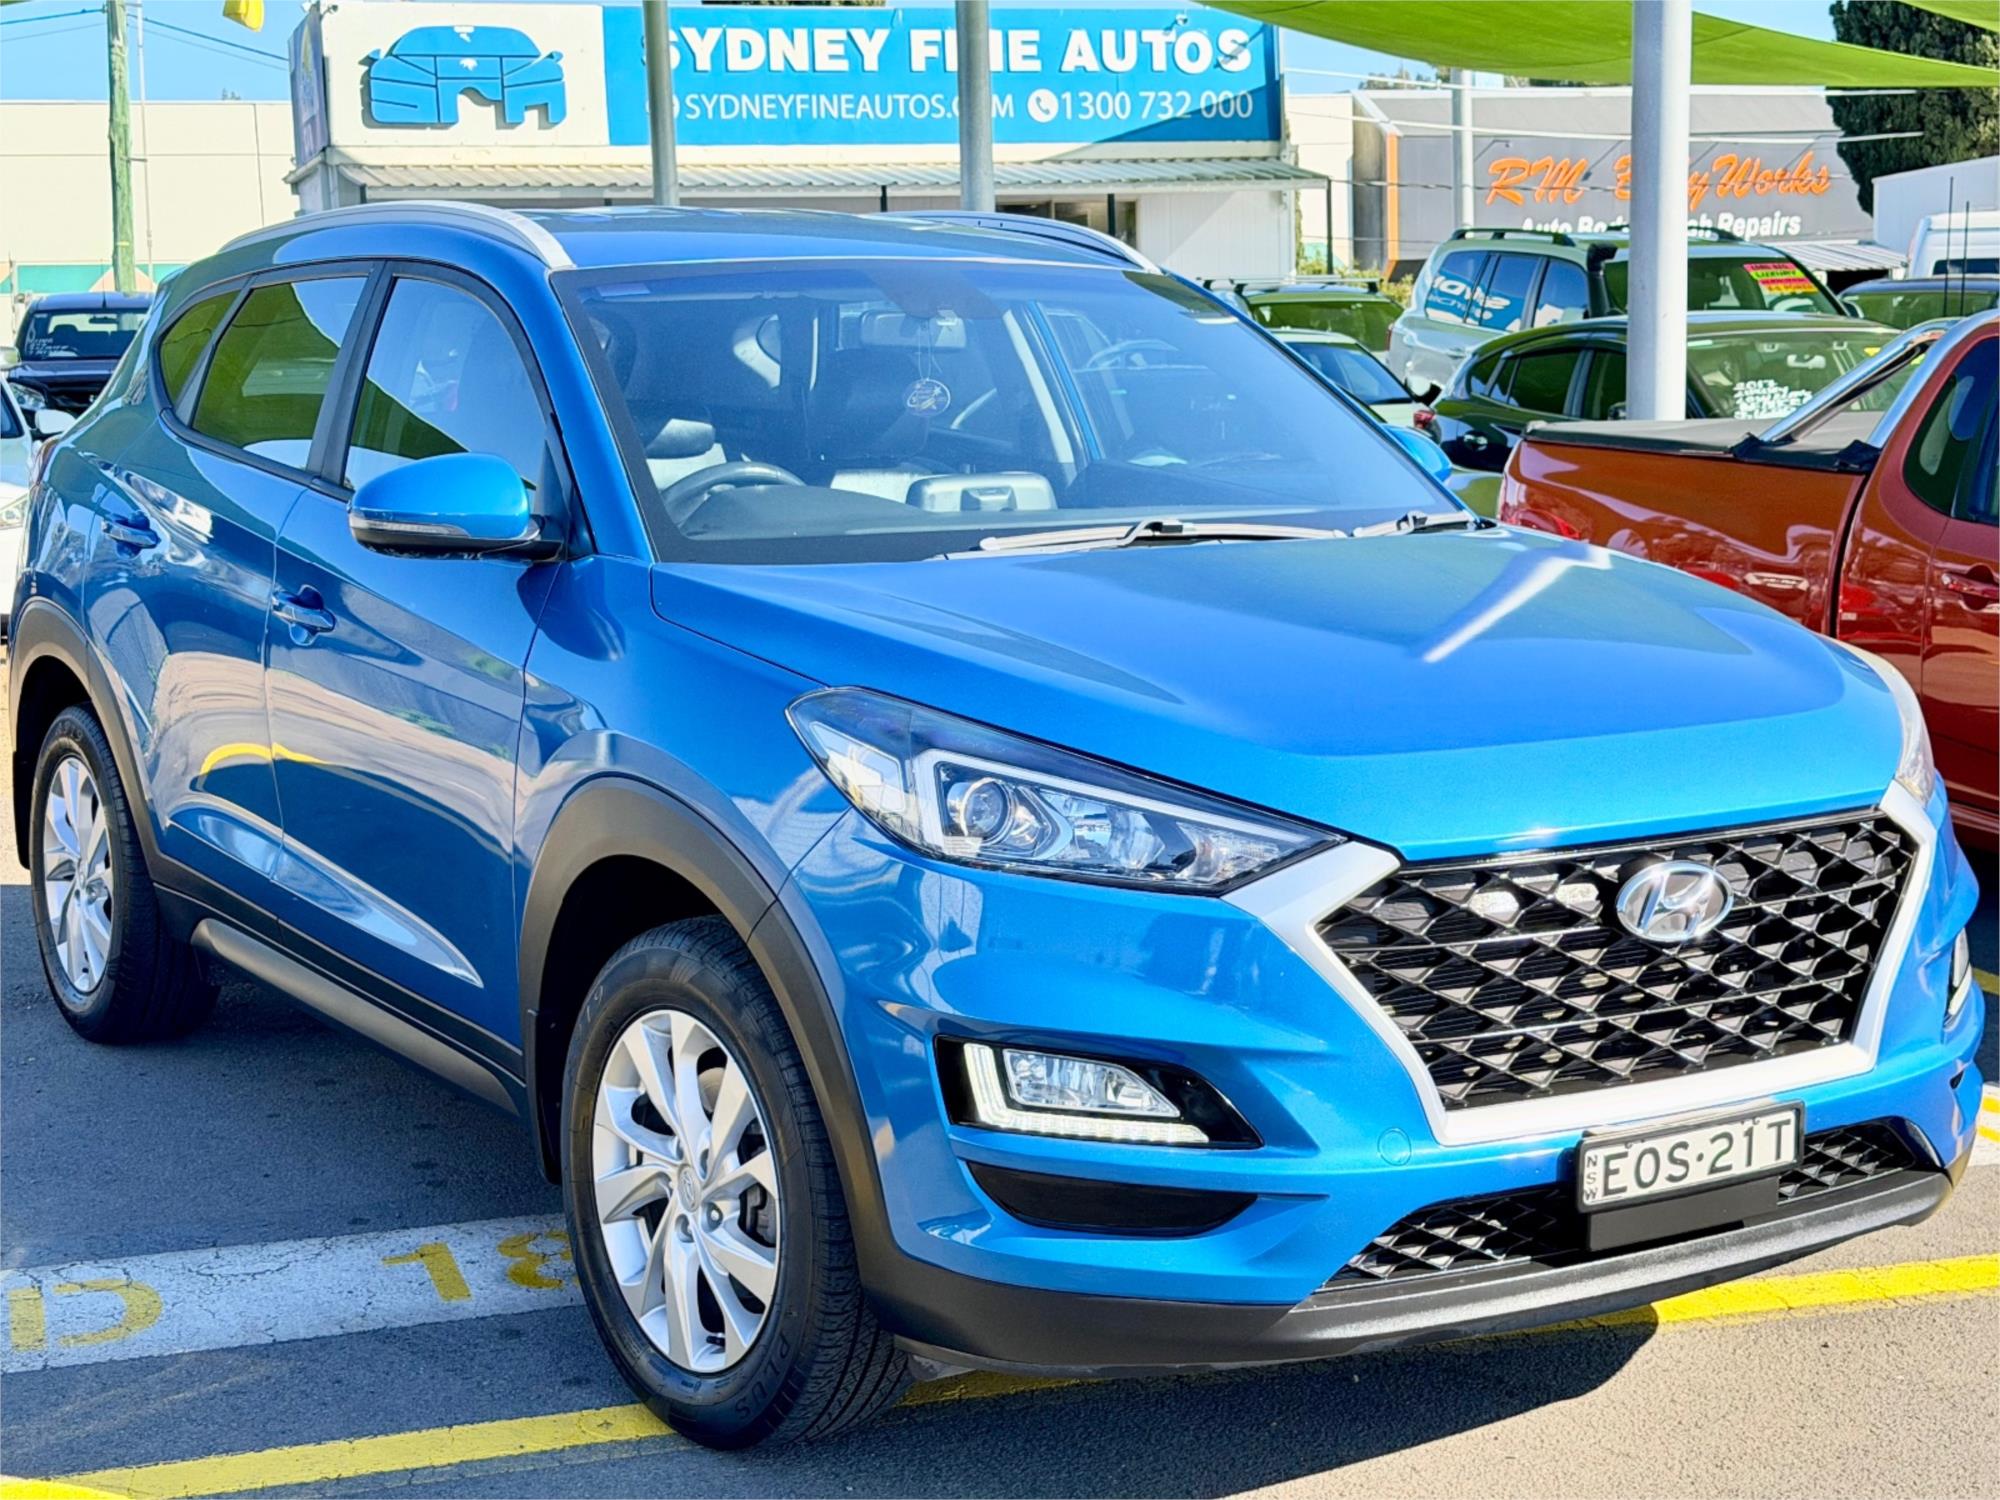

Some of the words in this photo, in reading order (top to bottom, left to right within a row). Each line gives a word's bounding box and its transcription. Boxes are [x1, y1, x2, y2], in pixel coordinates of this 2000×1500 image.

[1060, 29, 1252, 74] AUTOS
[685, 93, 1015, 119] SYDNEYFINEAUTOS.M
[1061, 91, 1131, 120] 1300
[1139, 91, 1192, 119] 732
[1201, 90, 1253, 118] 000
[1486, 155, 1588, 206] RM
[1712, 150, 1831, 198] Works
[1717, 210, 1802, 241] Repairs
[735, 1334, 792, 1420] PLUS
